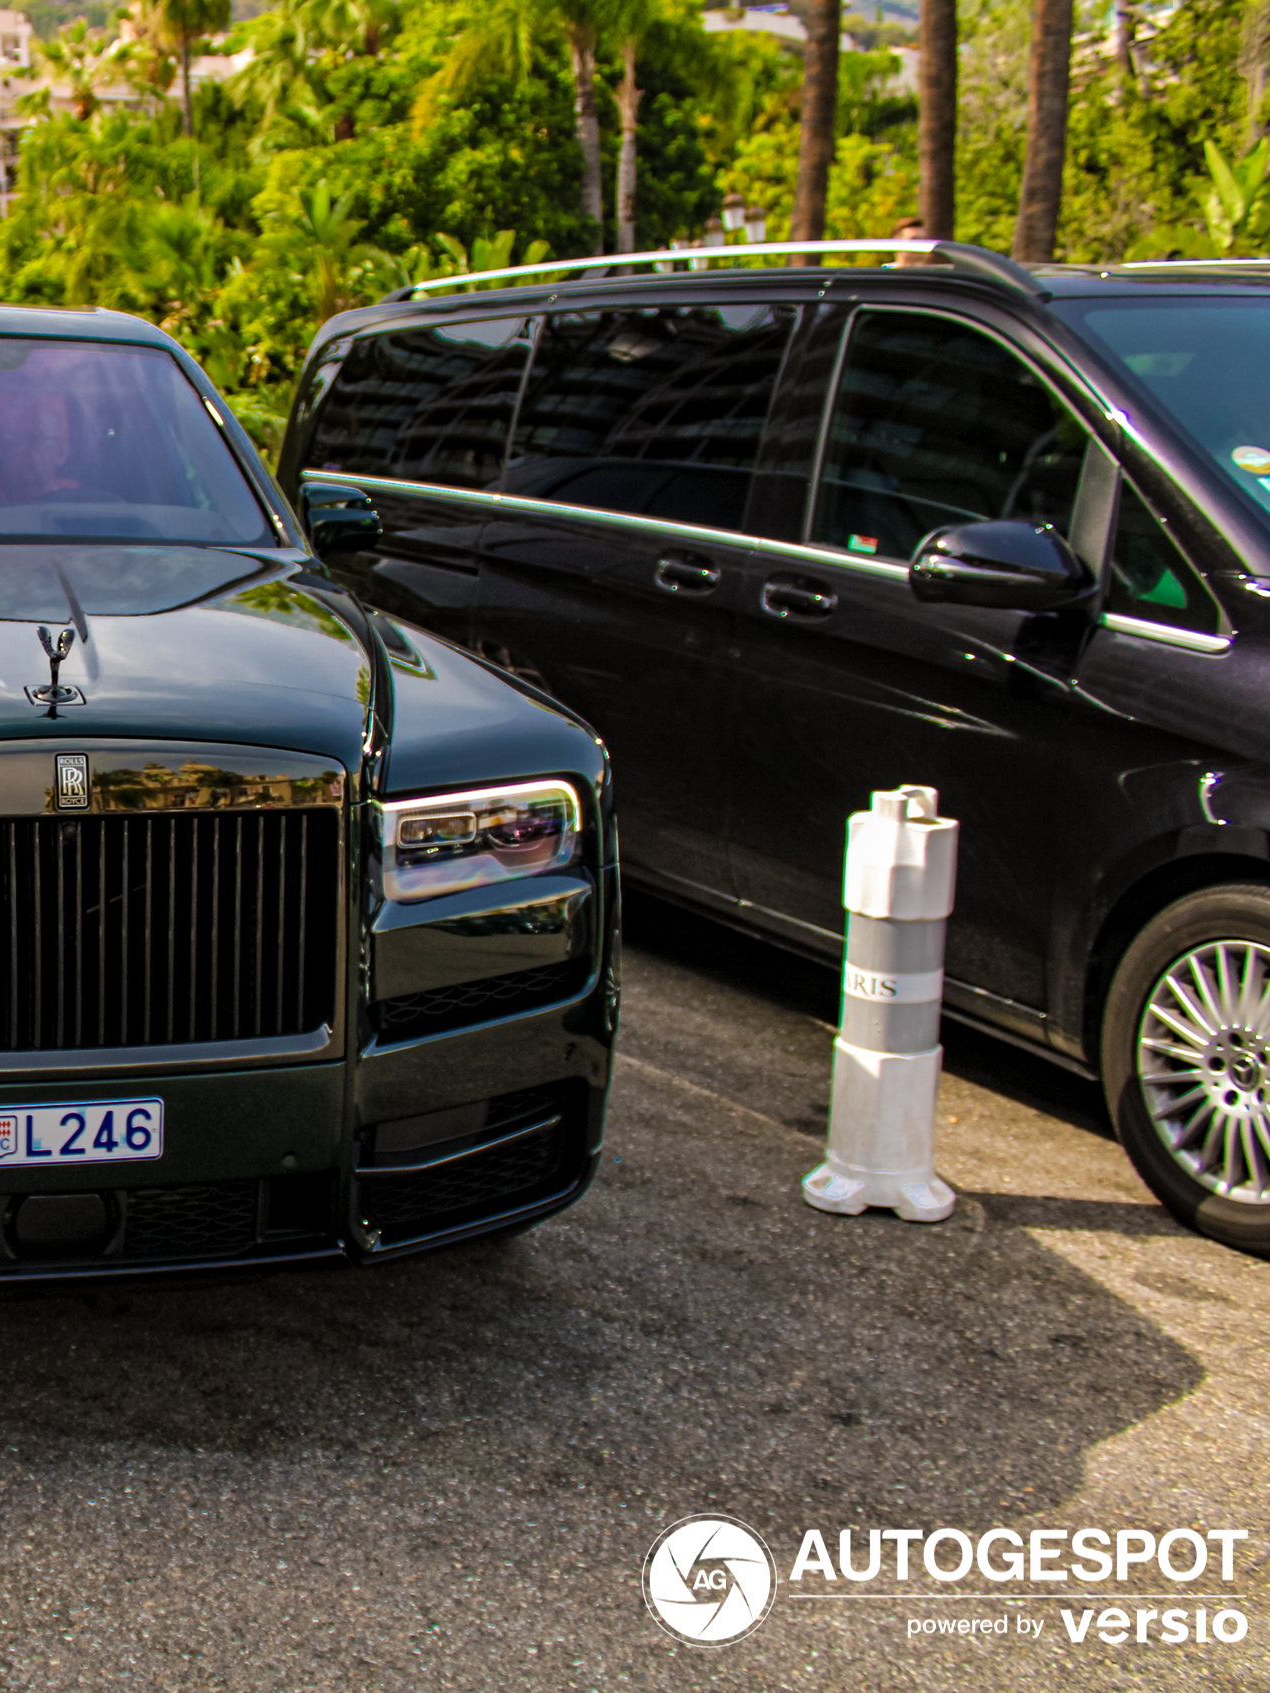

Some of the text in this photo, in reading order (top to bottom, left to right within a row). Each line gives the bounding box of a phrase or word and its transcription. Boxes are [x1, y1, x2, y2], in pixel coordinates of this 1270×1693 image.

[59, 757, 84, 765] ROLLS
[61, 797, 85, 805] ROYCE
[26, 1107, 153, 1157] L246
